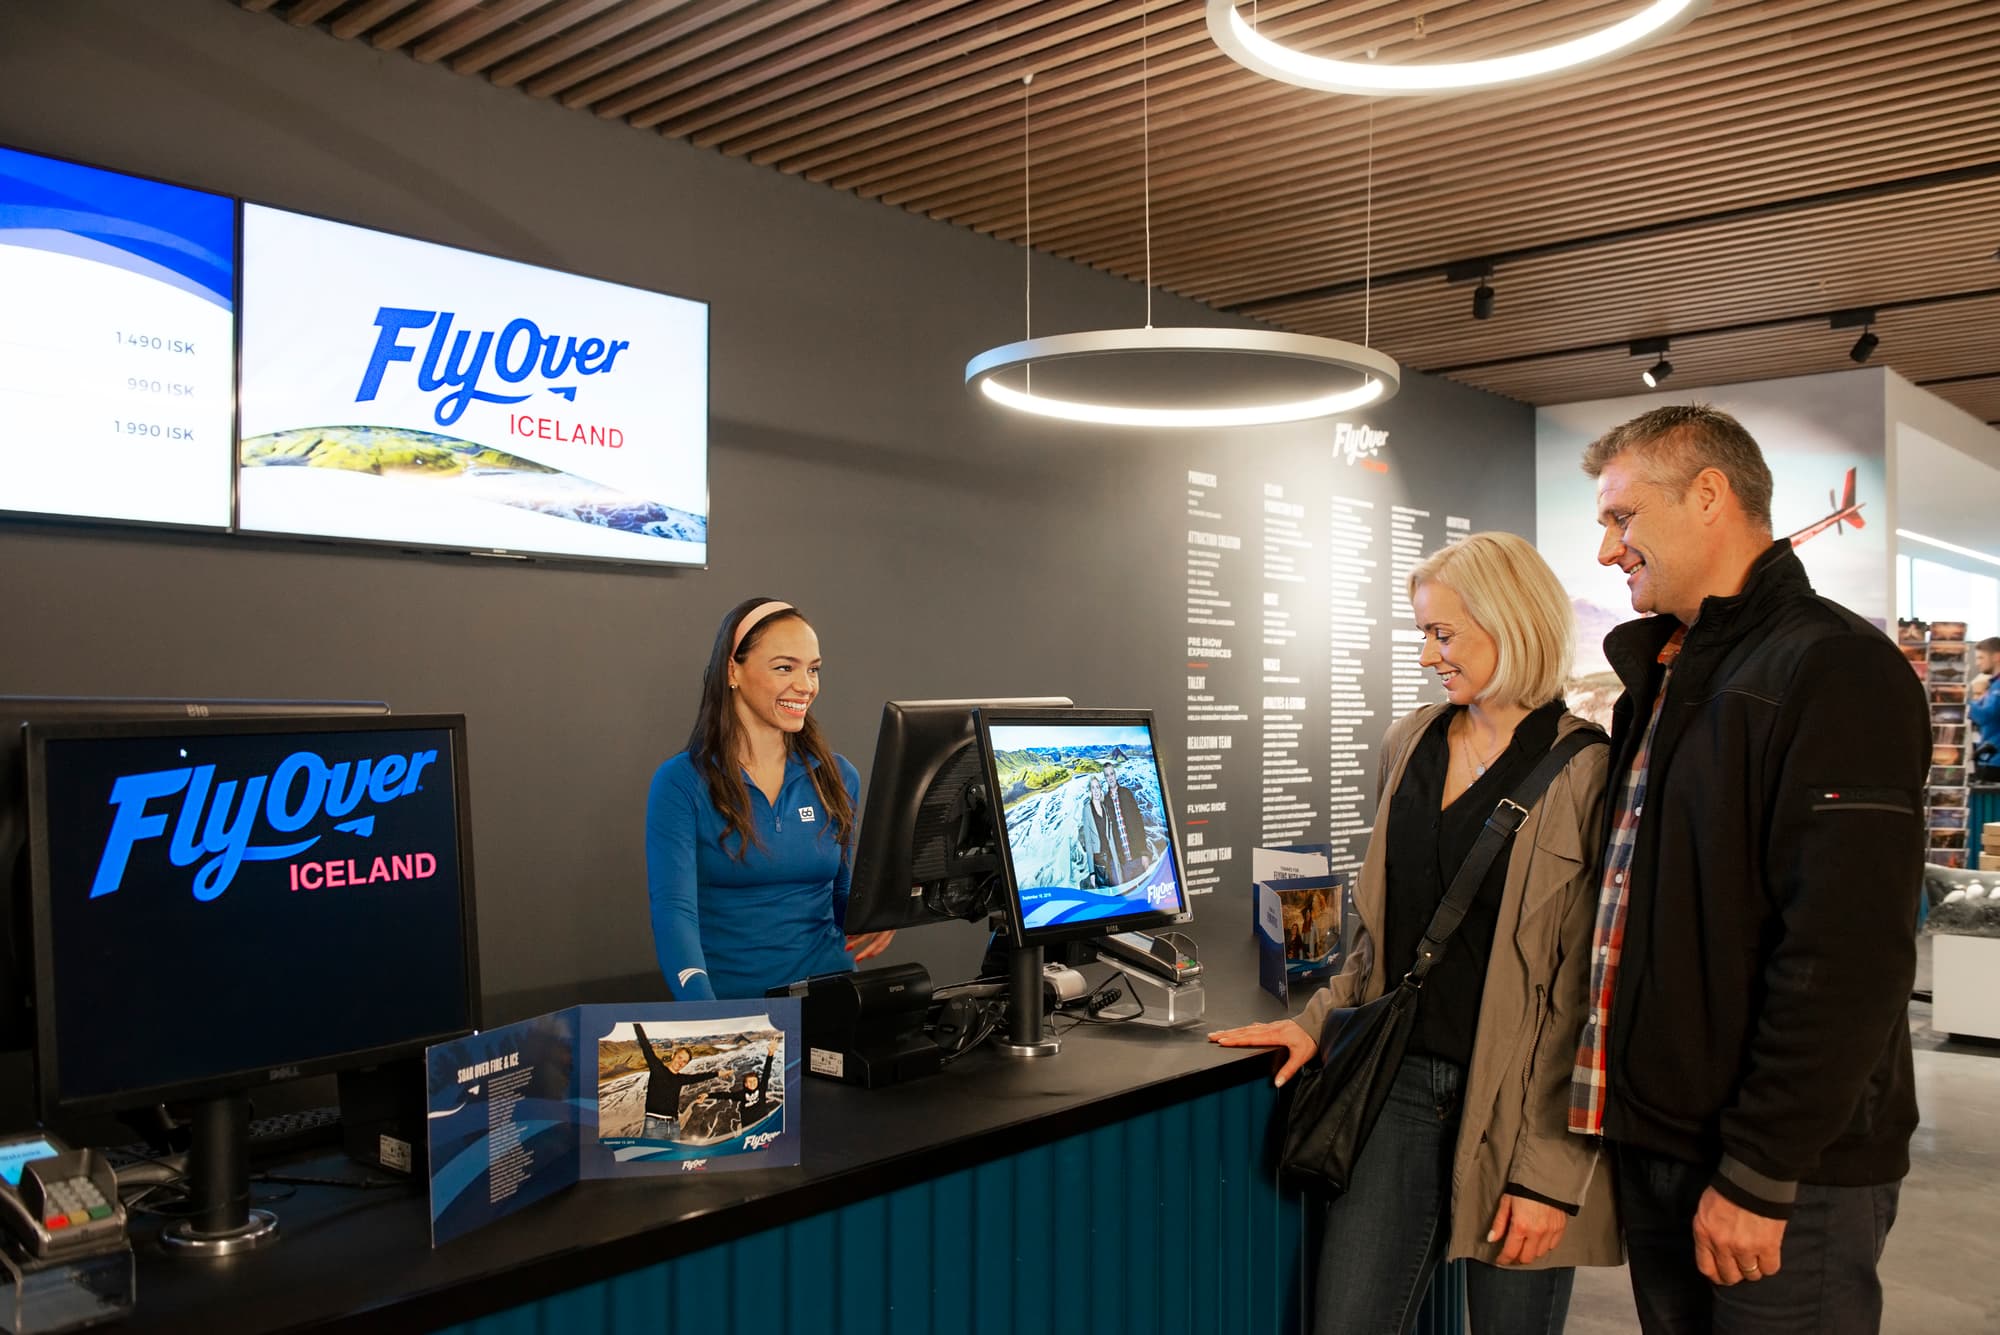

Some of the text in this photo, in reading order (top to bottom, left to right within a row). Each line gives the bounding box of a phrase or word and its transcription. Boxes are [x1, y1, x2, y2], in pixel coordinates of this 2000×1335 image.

[167, 339, 195, 355] ISK
[355, 306, 630, 426] FlyOver
[127, 377, 194, 398] 990 ISK
[166, 426, 194, 441] ISK
[510, 414, 624, 449] ICELAND
[1332, 422, 1390, 466] FlyOver
[1187, 637, 1223, 648] PRE SHOW
[1187, 647, 1232, 659] EXPERIENCES
[1187, 801, 1227, 814] FLYING RIDE
[89, 750, 438, 902] FlyOver
[289, 852, 437, 891] ICELAND
[1147, 881, 1176, 905] FlyOver
[457, 1066, 474, 1084] SOAR
[474, 1061, 490, 1078] OVER
[490, 1057, 503, 1073] FIRE
[509, 1052, 520, 1067] ICE
[743, 1130, 781, 1150] FlyOver
